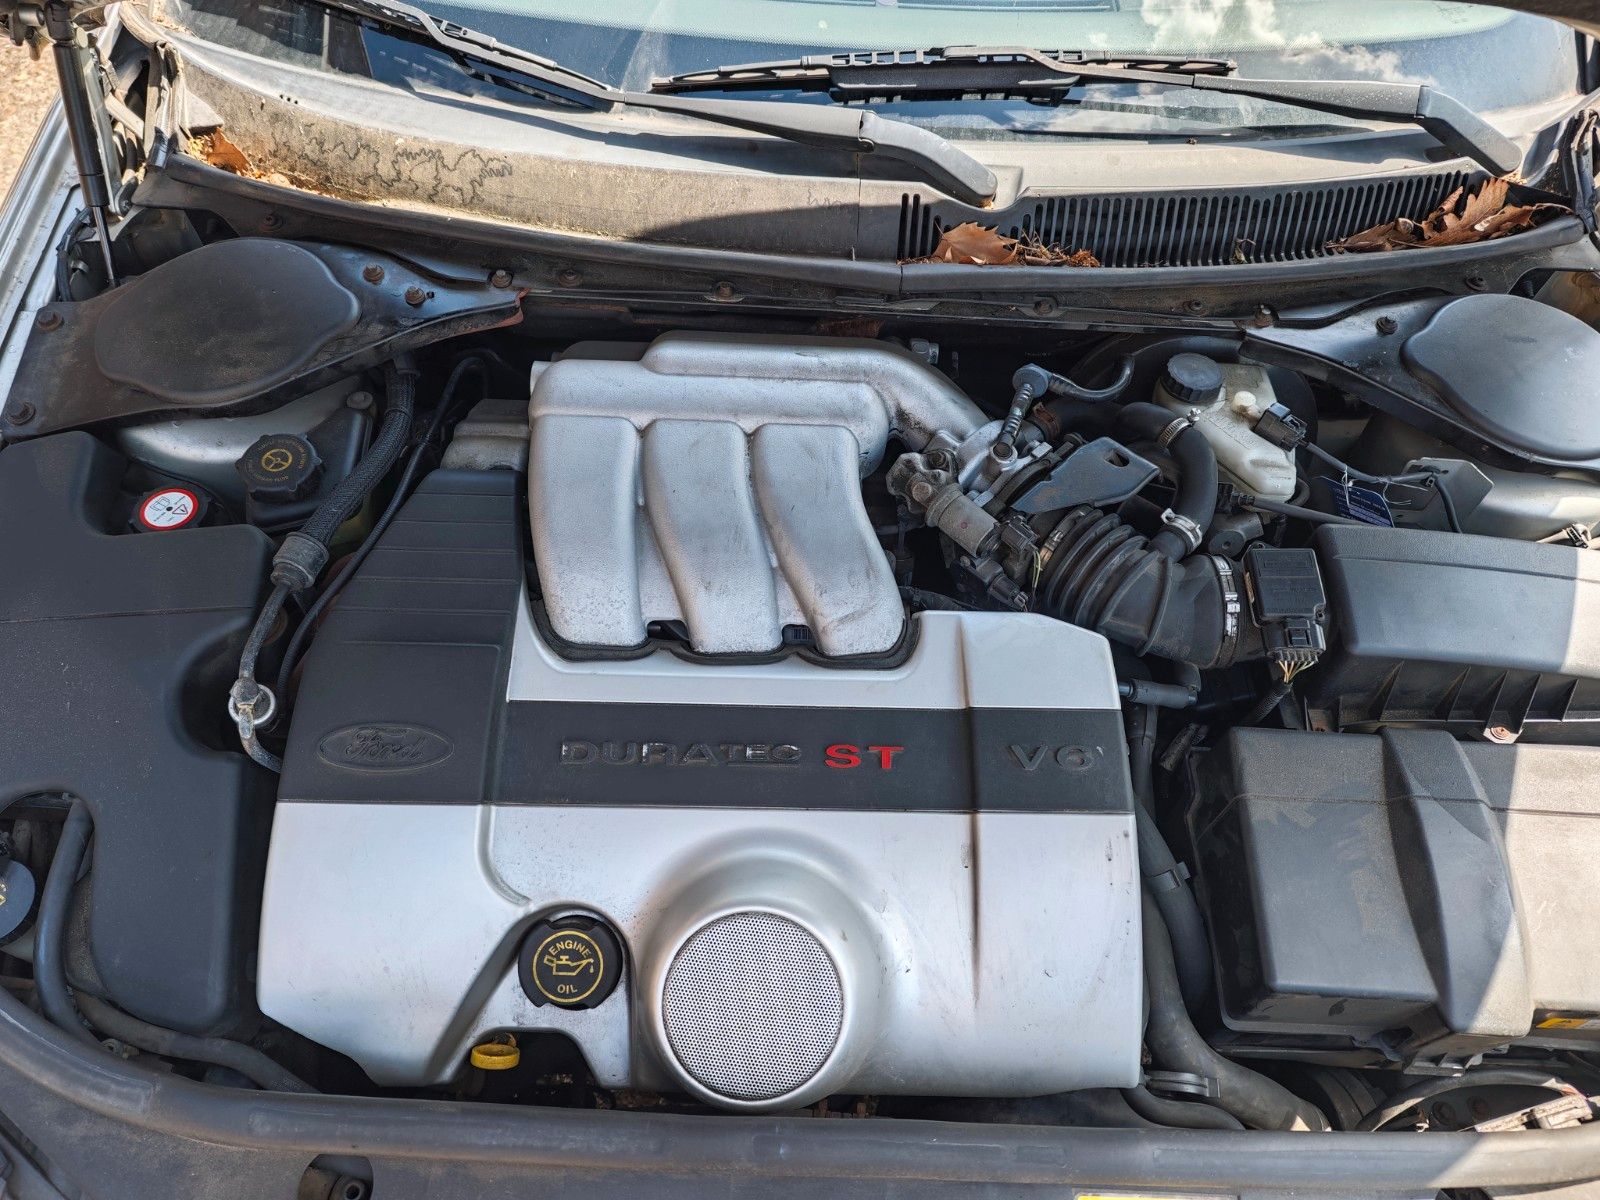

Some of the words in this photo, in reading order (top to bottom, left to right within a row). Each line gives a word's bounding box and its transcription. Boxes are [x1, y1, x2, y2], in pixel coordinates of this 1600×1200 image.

[345, 727, 426, 761] Ford
[560, 741, 801, 766] DURATEC
[824, 744, 904, 769] ST
[1009, 744, 1096, 771] V6
[548, 940, 591, 958] ENGINE
[557, 984, 578, 994] OIL
